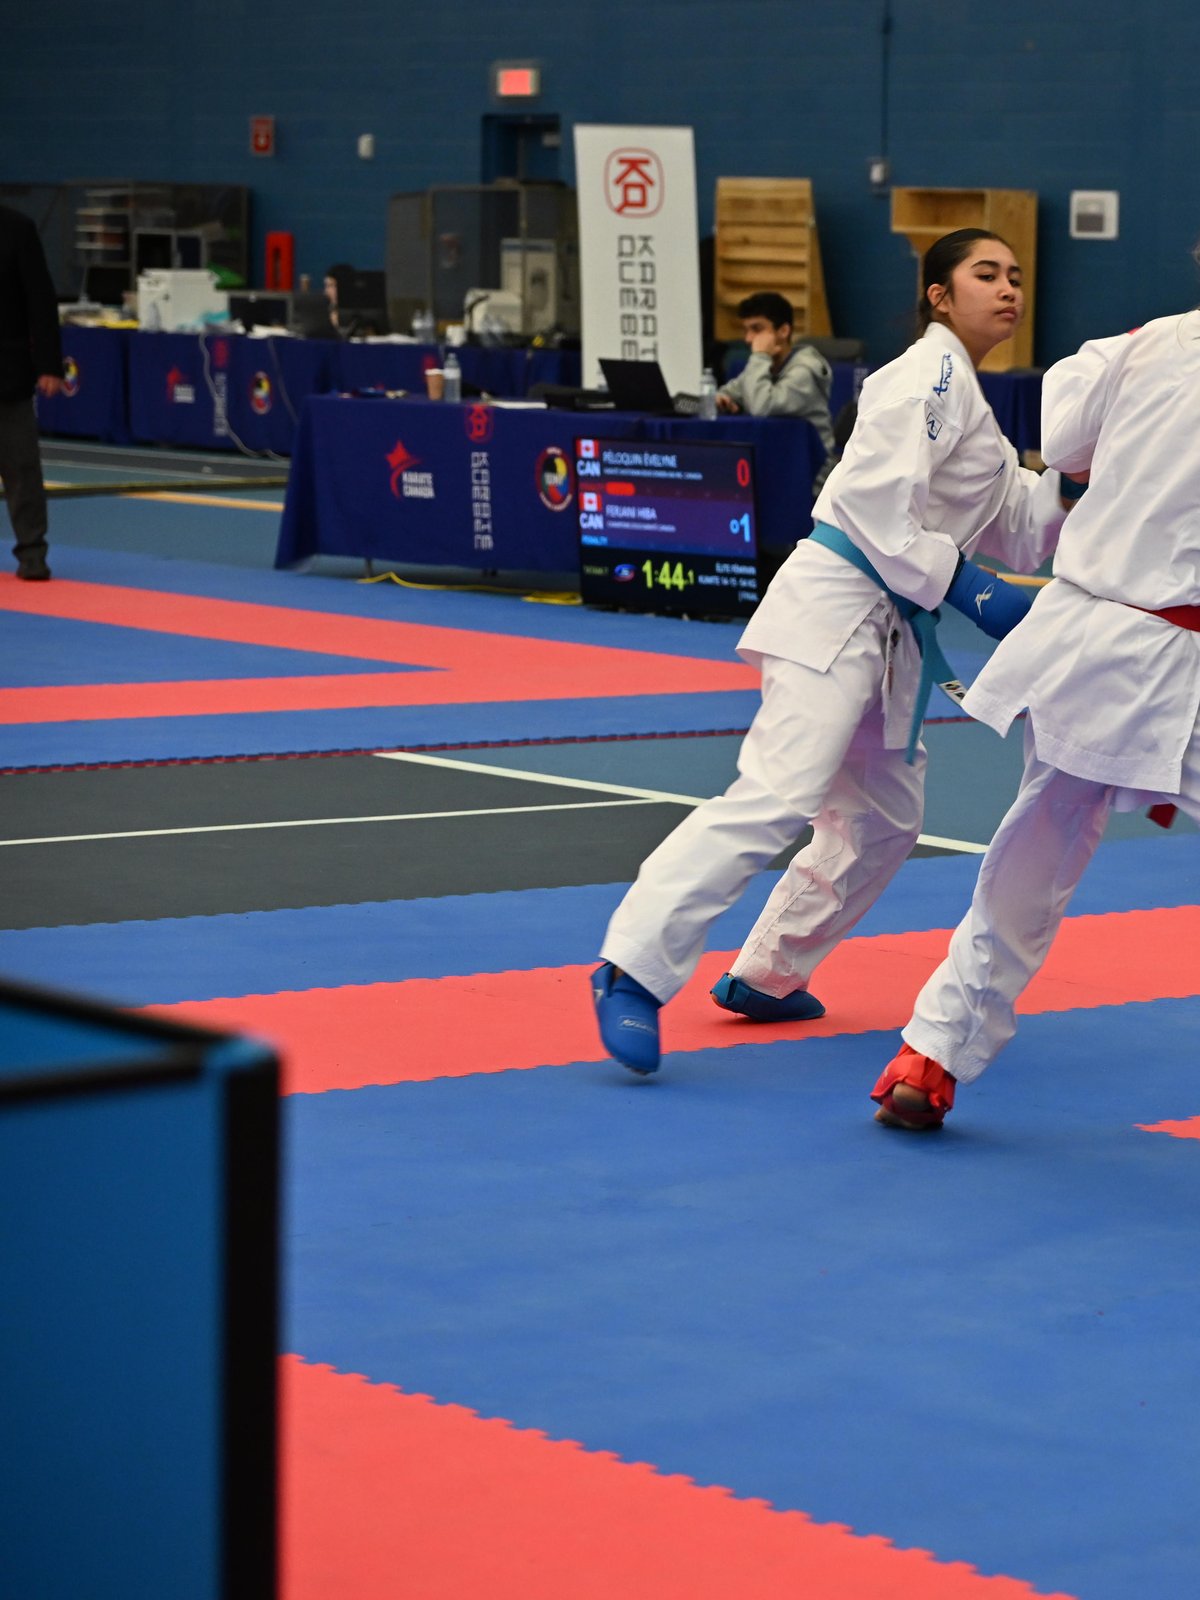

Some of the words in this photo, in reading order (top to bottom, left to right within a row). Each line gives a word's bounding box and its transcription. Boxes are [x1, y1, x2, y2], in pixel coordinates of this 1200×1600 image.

[617, 235, 638, 362] QUÉBE
[638, 235, 658, 362] KARAT
[576, 460, 600, 477] CAN
[736, 458, 749, 487] 0
[579, 513, 604, 530] CAN
